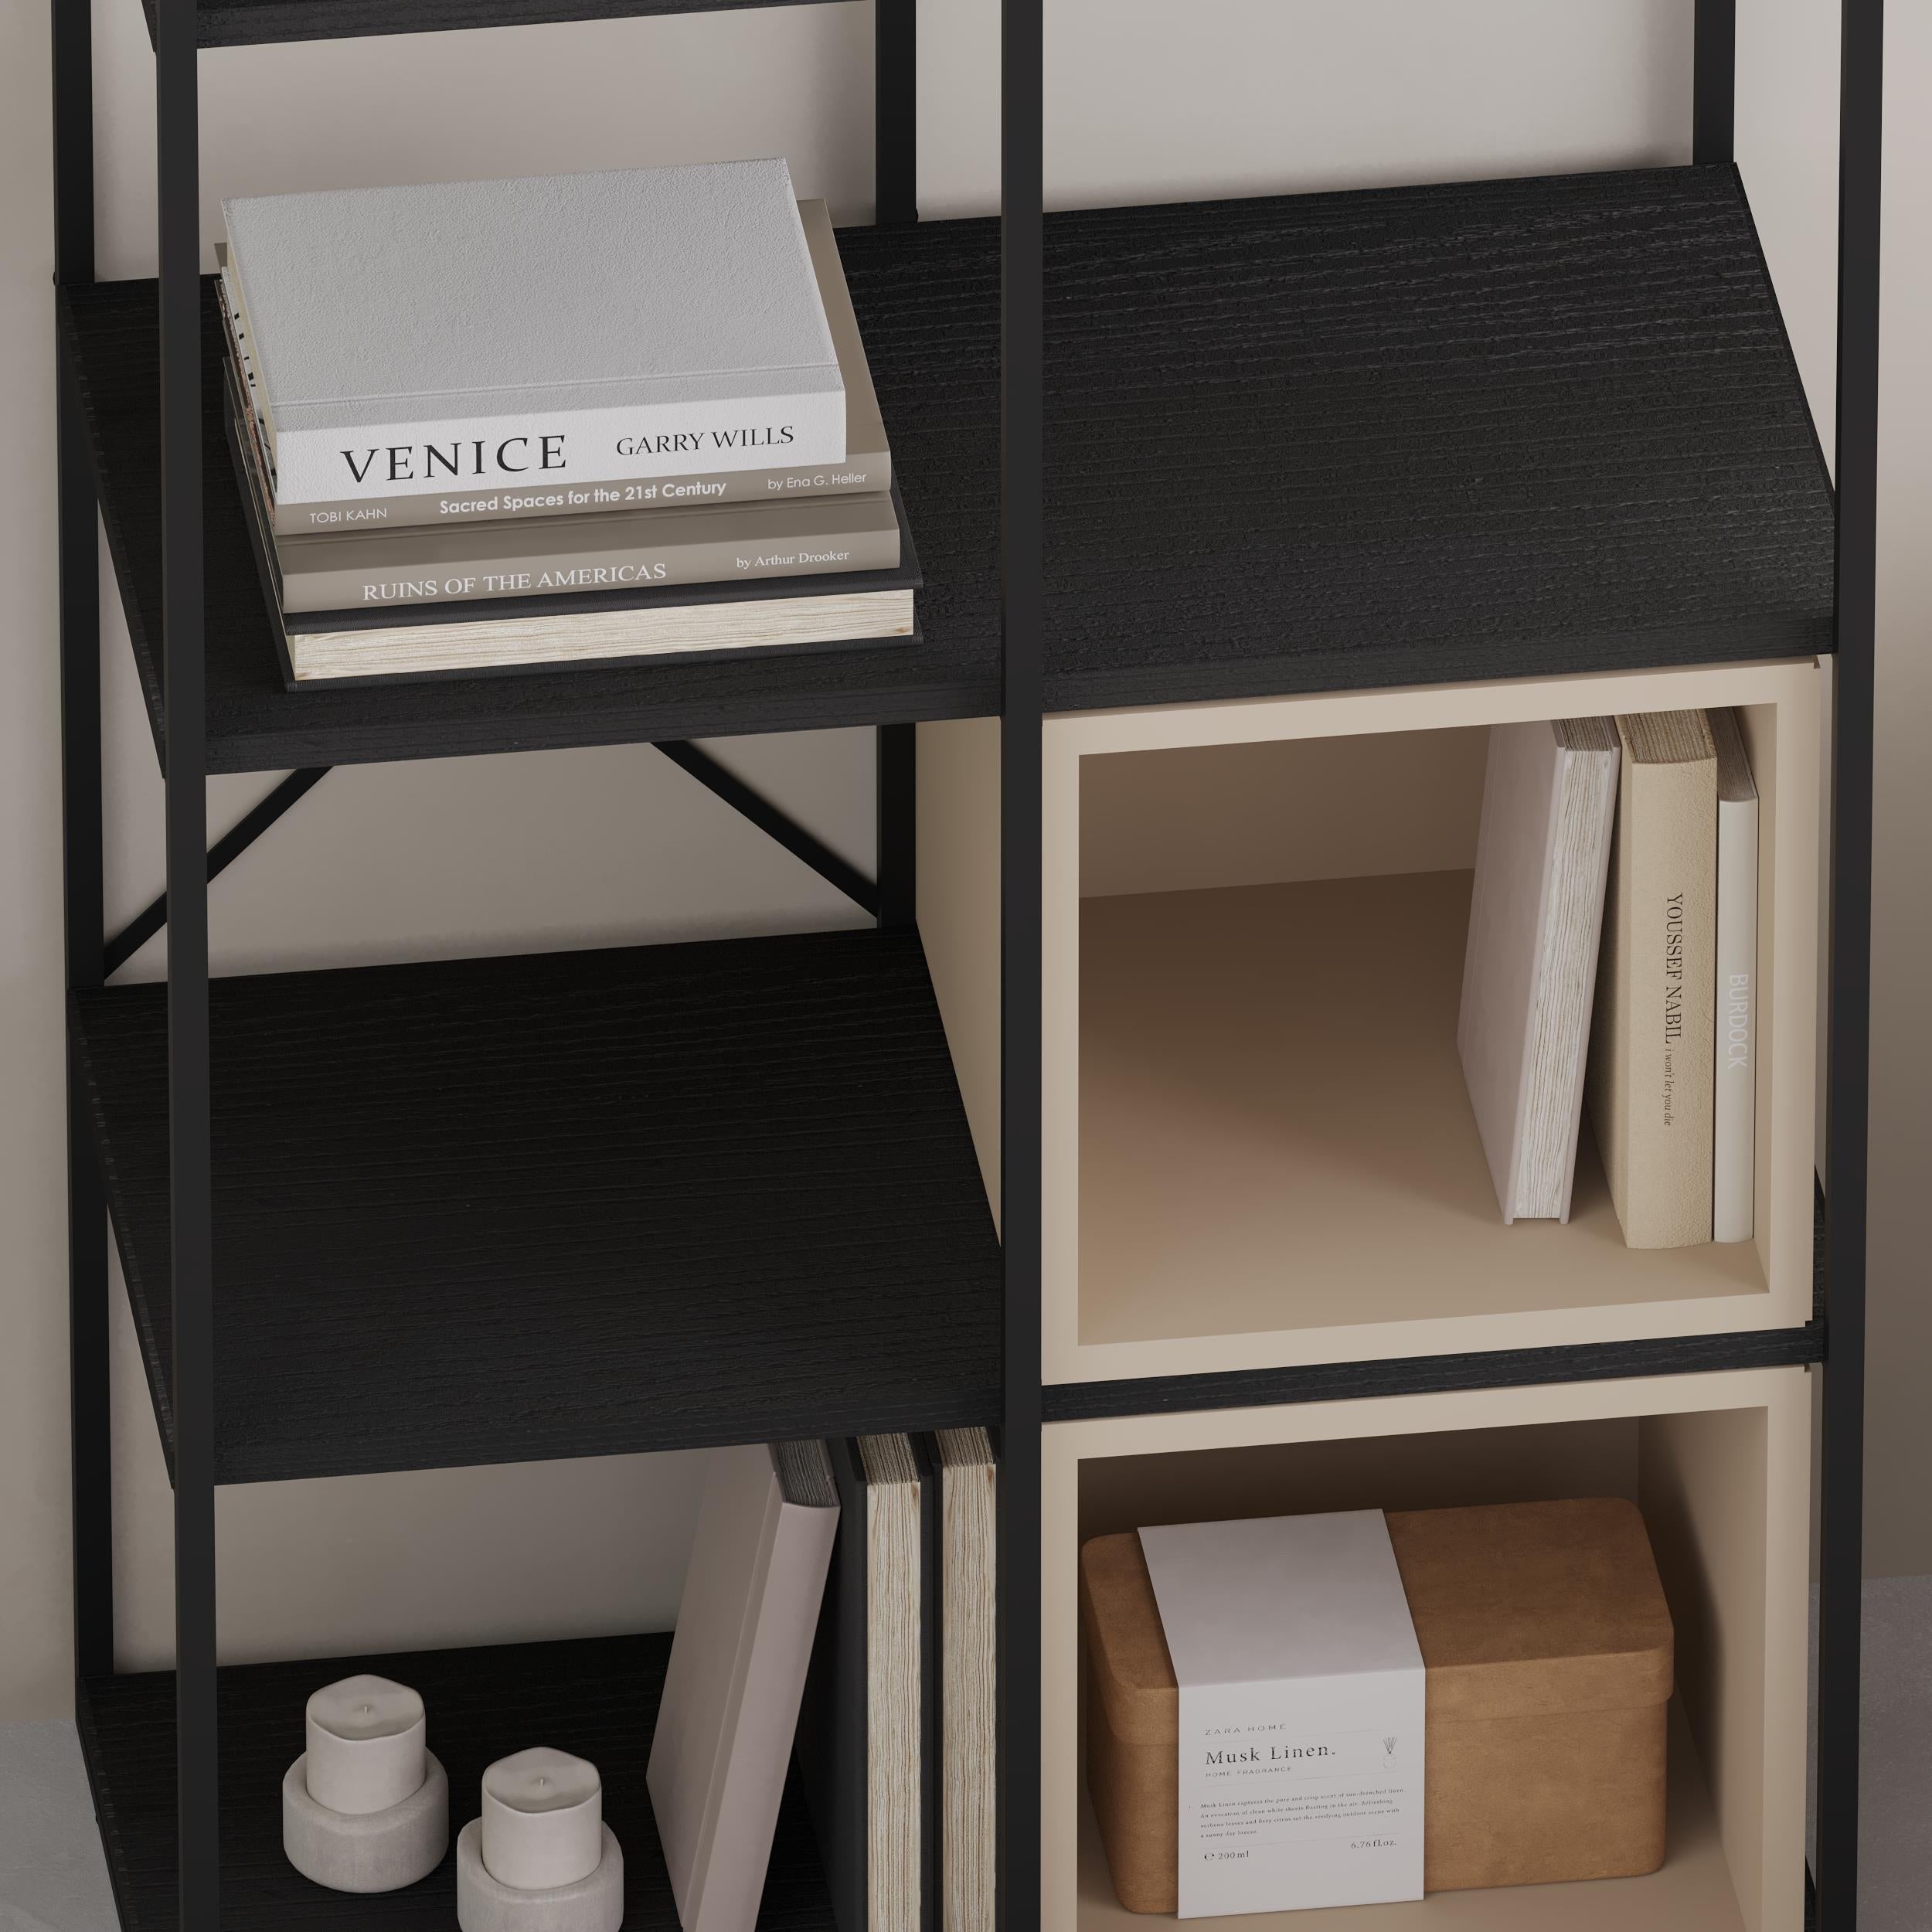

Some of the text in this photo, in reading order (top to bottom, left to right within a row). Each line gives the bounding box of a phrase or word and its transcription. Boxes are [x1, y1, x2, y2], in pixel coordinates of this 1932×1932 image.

[616, 424, 794, 457] GARRY WILLS
[340, 434, 569, 484] VENICE
[767, 471, 867, 492] by Ena G. Heller
[440, 479, 726, 515] Sacred Spaces for the 21st Century
[309, 506, 387, 524] TOBI KAHN
[736, 549, 849, 570] by Arthur Drooker
[362, 563, 667, 600] RUINS OF THE AMERICAS
[1665, 893, 1683, 981] YOUSSEF
[1665, 985, 1682, 1044] NABIL
[1727, 974, 1749, 1070] BURDOCK
[1665, 1080, 1675, 1091] let
[1662, 1092, 1672, 1111] you
[1663, 1112, 1675, 1126] die
[1205, 1727, 1241, 1736] ZARA
[1205, 1744, 1336, 1764] Musk Linen.
[1237, 1766, 1293, 1775] FRAGRANCE
